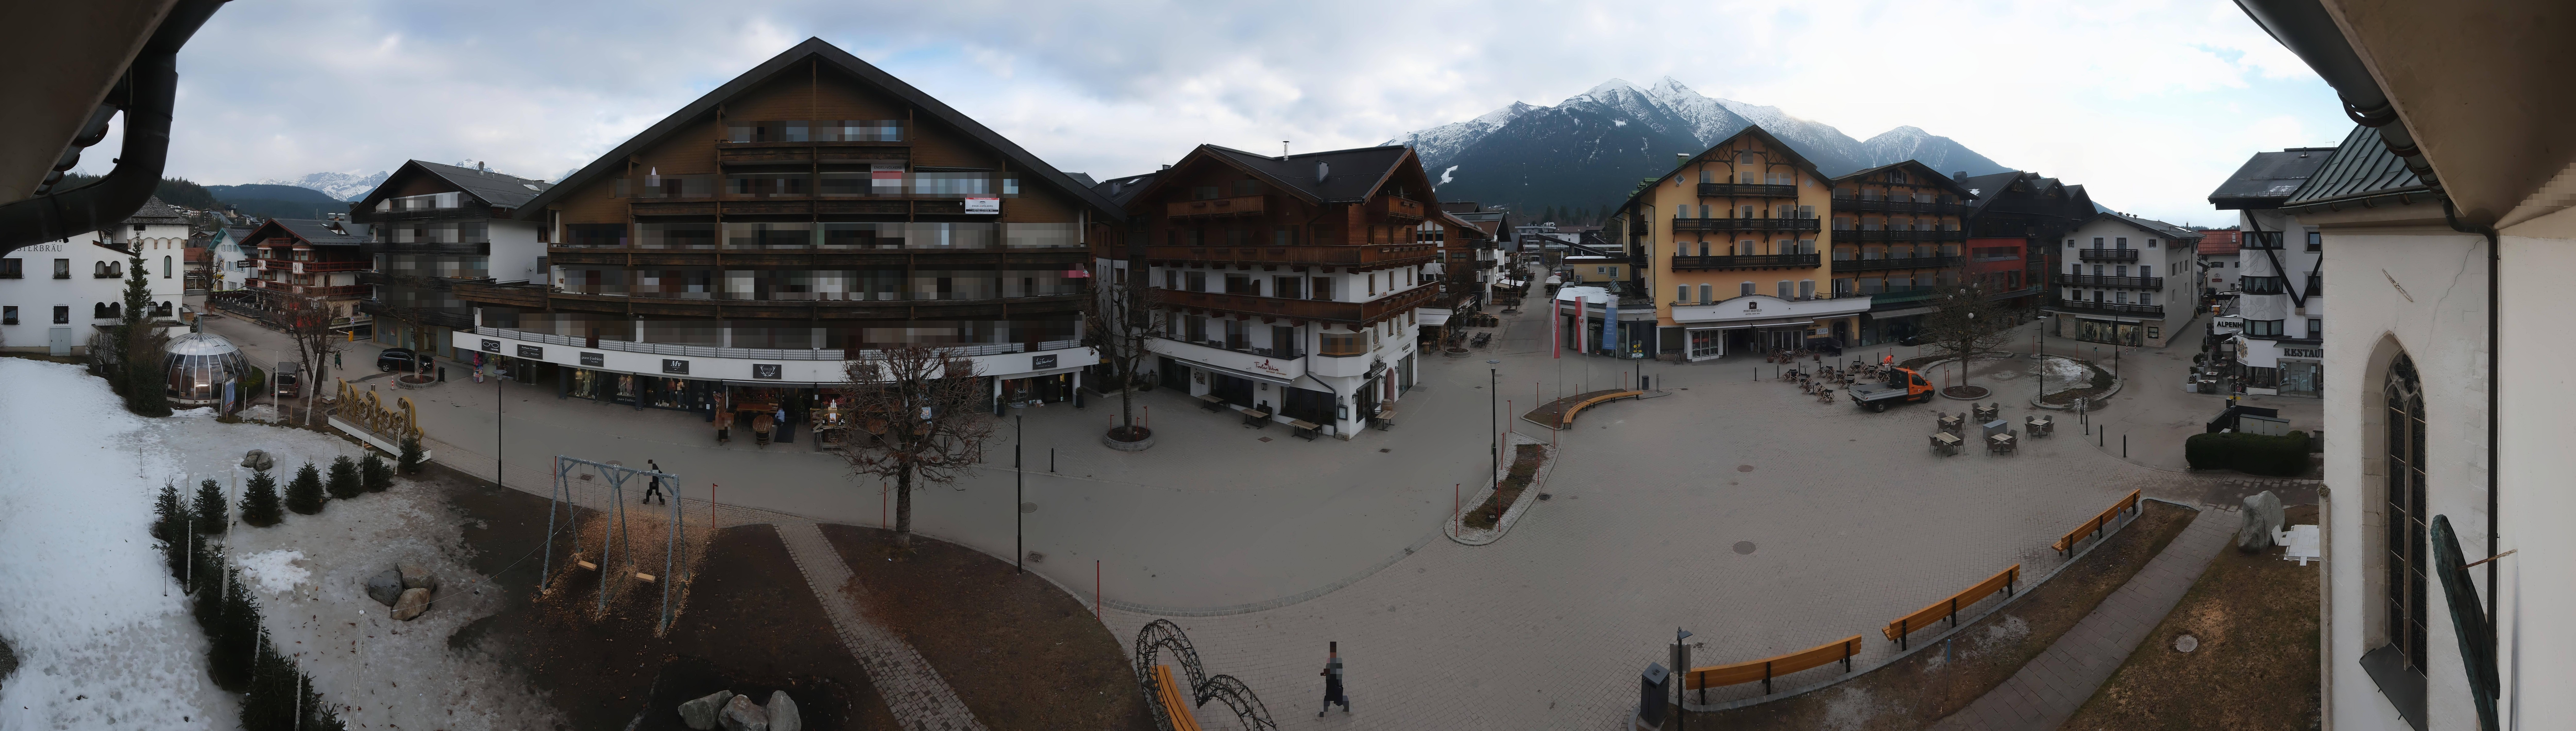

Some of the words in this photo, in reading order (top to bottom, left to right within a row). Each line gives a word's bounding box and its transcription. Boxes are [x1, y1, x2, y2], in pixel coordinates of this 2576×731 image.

[1402, 343, 1410, 352] SAILER
[2237, 355, 2248, 365] Kaltschmid
[1371, 364, 1385, 377] RESTAURANT
